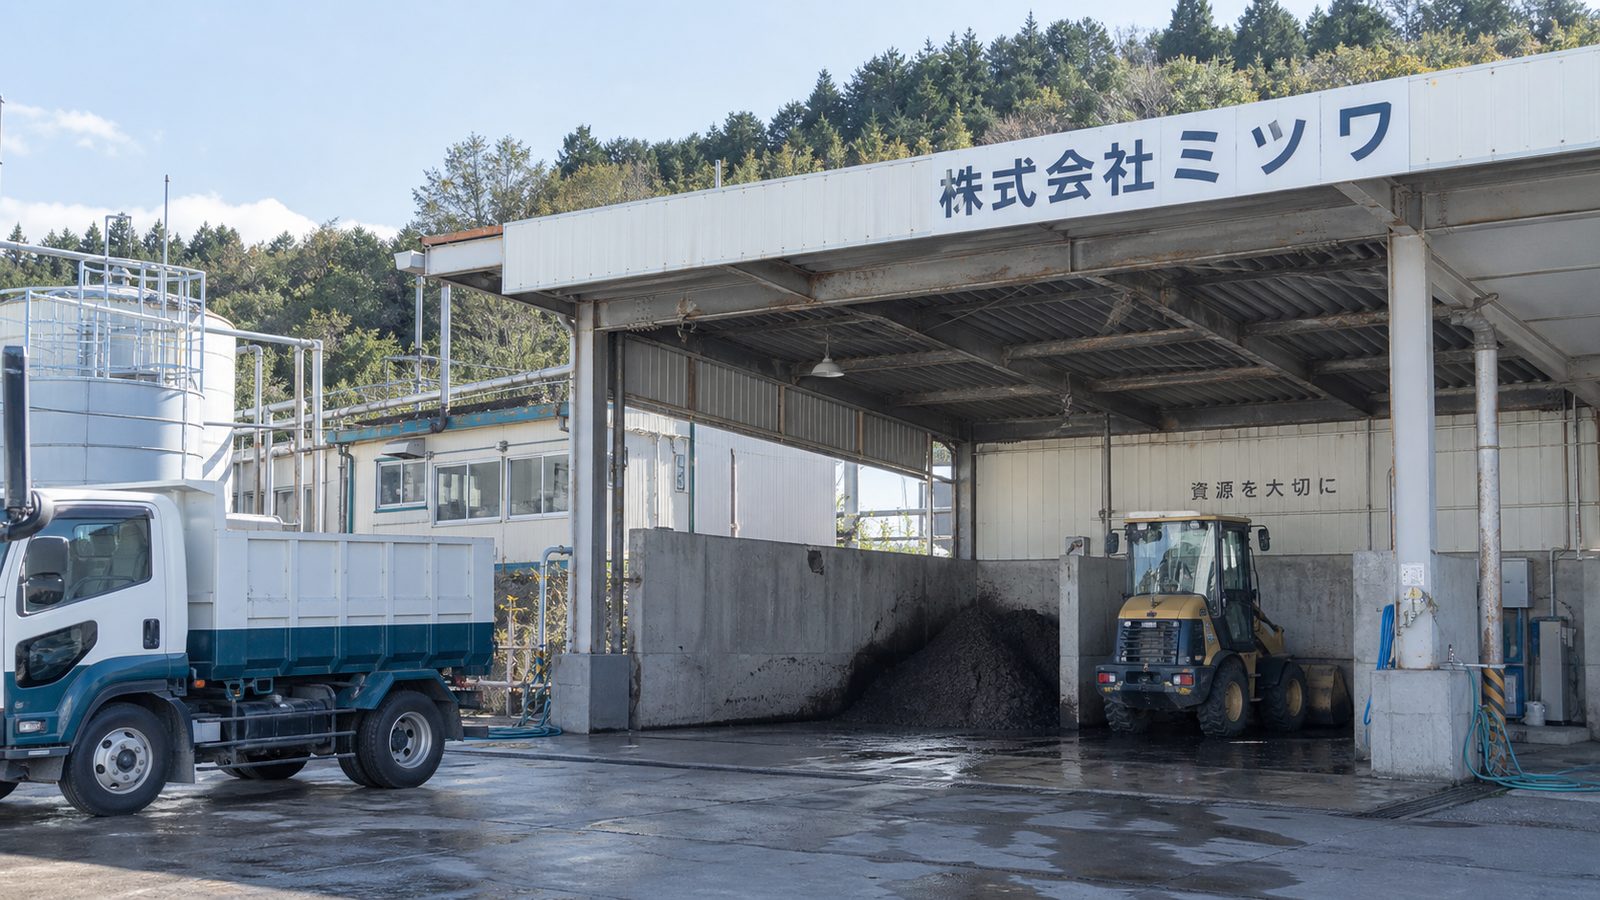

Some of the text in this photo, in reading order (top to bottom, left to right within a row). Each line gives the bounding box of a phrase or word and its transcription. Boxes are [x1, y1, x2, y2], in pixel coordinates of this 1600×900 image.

[939, 101, 1392, 218] 株式会社ミツワ
[1191, 477, 1337, 500] 資源を大切に
